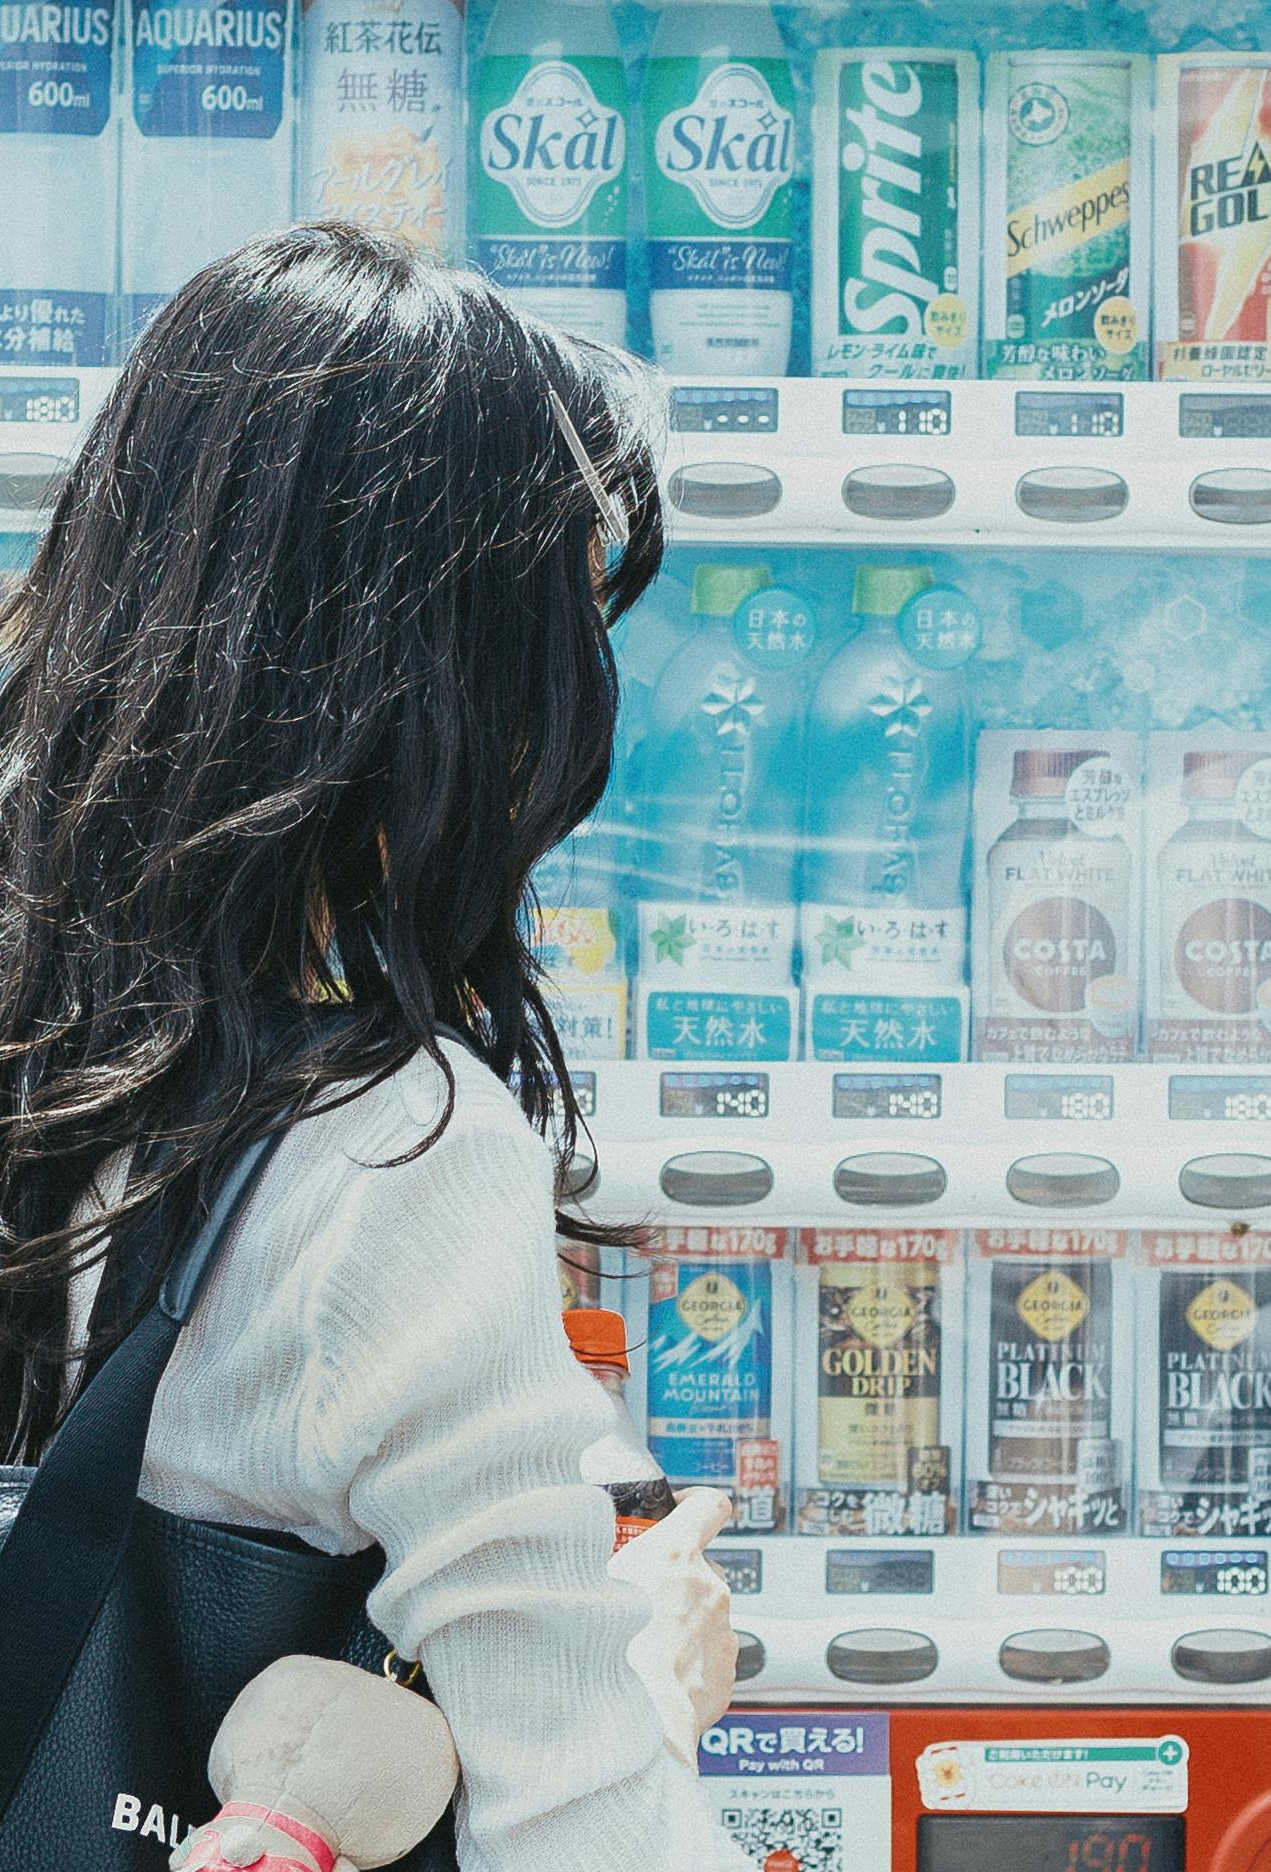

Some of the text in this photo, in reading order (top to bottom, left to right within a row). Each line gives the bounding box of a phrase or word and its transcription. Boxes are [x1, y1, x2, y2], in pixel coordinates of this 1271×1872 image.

[136, 7, 283, 50] AQUARIUS
[324, 22, 443, 55] 紅茶花伝
[28, 81, 90, 108] 600ml
[201, 84, 263, 111] 600ml
[337, 68, 430, 114] 無糖
[843, 61, 939, 334] Sprite
[1006, 179, 1130, 258] Schweppes
[26, 395, 76, 423] 180
[747, 611, 807, 629] 日本の
[915, 611, 976, 629] 日本の
[745, 632, 808, 652] 天然水
[914, 632, 977, 652] 天然水
[1069, 788, 1130, 803] エスプレッソ
[1013, 937, 1107, 962] COSTA
[672, 1015, 767, 1048] 天然水
[839, 1017, 937, 1049] 天然水
[681, 1300, 744, 1312] GEORGIA
[850, 1306, 912, 1318] GEORGIA
[1022, 1300, 1083, 1312] GEORGIA
[1192, 1309, 1252, 1321] GEORGIA
[822, 1349, 937, 1377] GOLDEN
[997, 1341, 1106, 1362] PLATINUM
[668, 1373, 756, 1387] EMERALD
[851, 1376, 911, 1397] DRIP
[997, 1361, 1107, 1402] BLACK
[662, 1387, 758, 1402] MOUNTAIN
[863, 1490, 947, 1535] 微糖
[1025, 1487, 1119, 1528] シャキッと
[1216, 1566, 1267, 1594] 100
[700, 1725, 864, 1756] QRで買える!
[738, 1758, 825, 1773] Pay with QR
[729, 1788, 836, 1801] スキャンはこちらから
[1086, 1771, 1128, 1793] Pay
[111, 1792, 199, 1850] BAL
